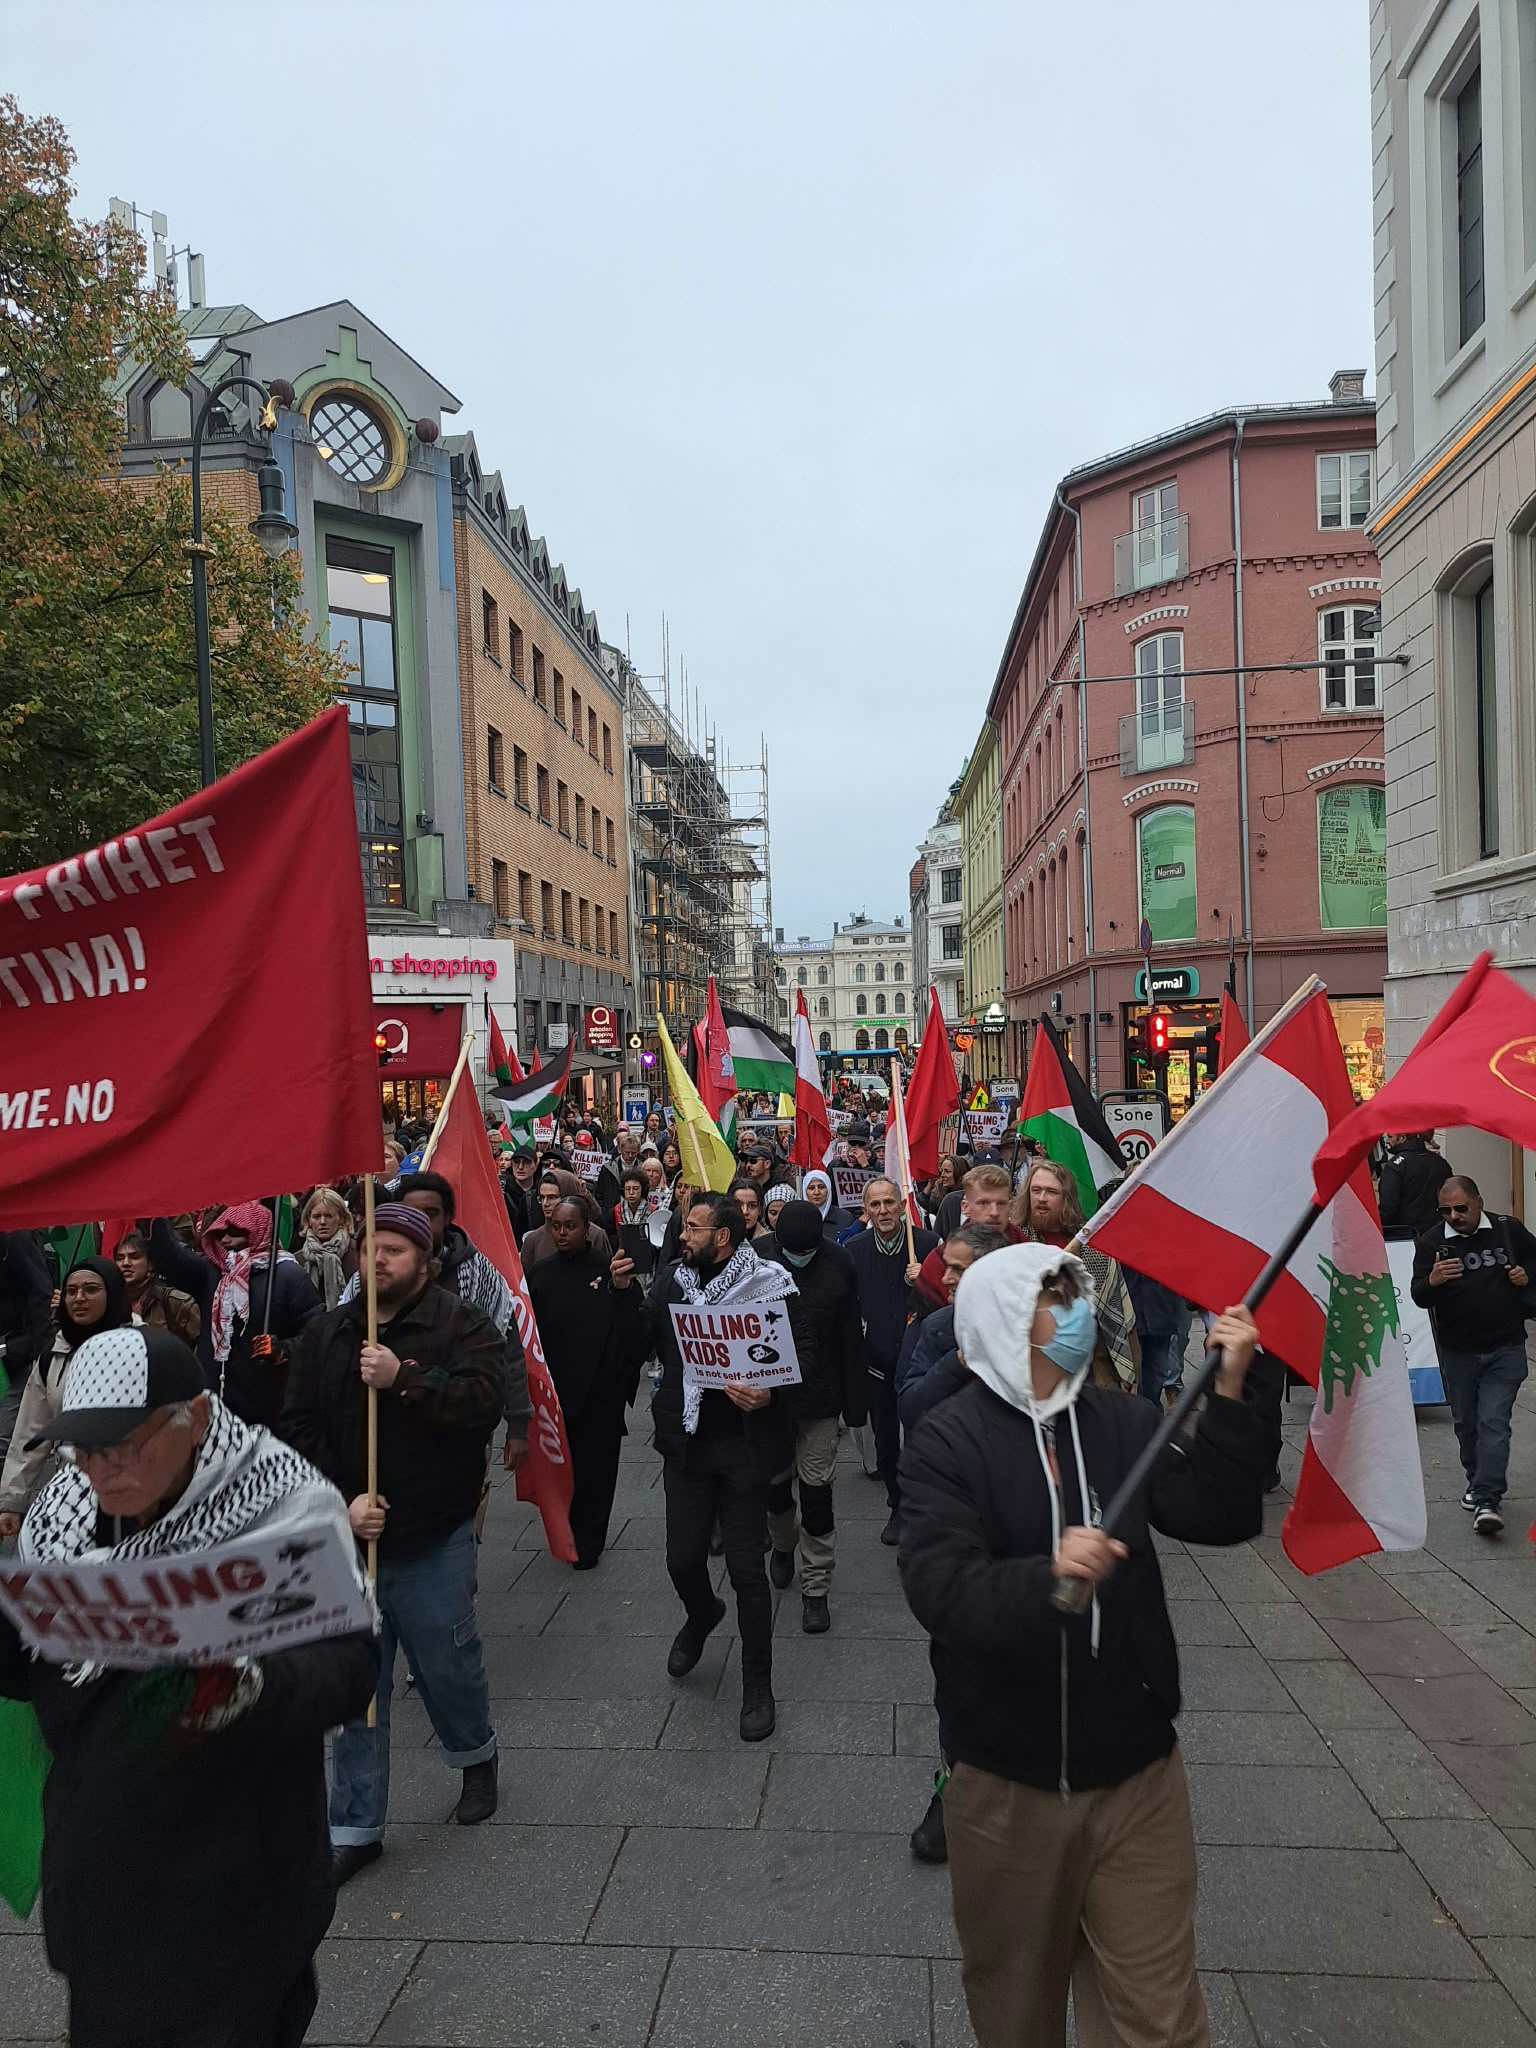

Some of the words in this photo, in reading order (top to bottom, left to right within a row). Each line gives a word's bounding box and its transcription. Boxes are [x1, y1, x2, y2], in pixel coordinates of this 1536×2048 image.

[1157, 866, 1183, 877] Normal
[393, 953, 497, 979] shopping
[0, 1079, 116, 1130] ME.NO
[1114, 1108, 1153, 1121] Sone
[574, 1152, 604, 1165] KILLING
[1120, 1140, 1150, 1162] 30
[674, 1313, 762, 1340] KILLING
[682, 1340, 731, 1368] KIDS
[705, 1369, 722, 1379] not
[722, 1365, 793, 1381] self-defense
[0, 1555, 268, 1611] KILLING
[24, 1606, 181, 1646] KIDS
